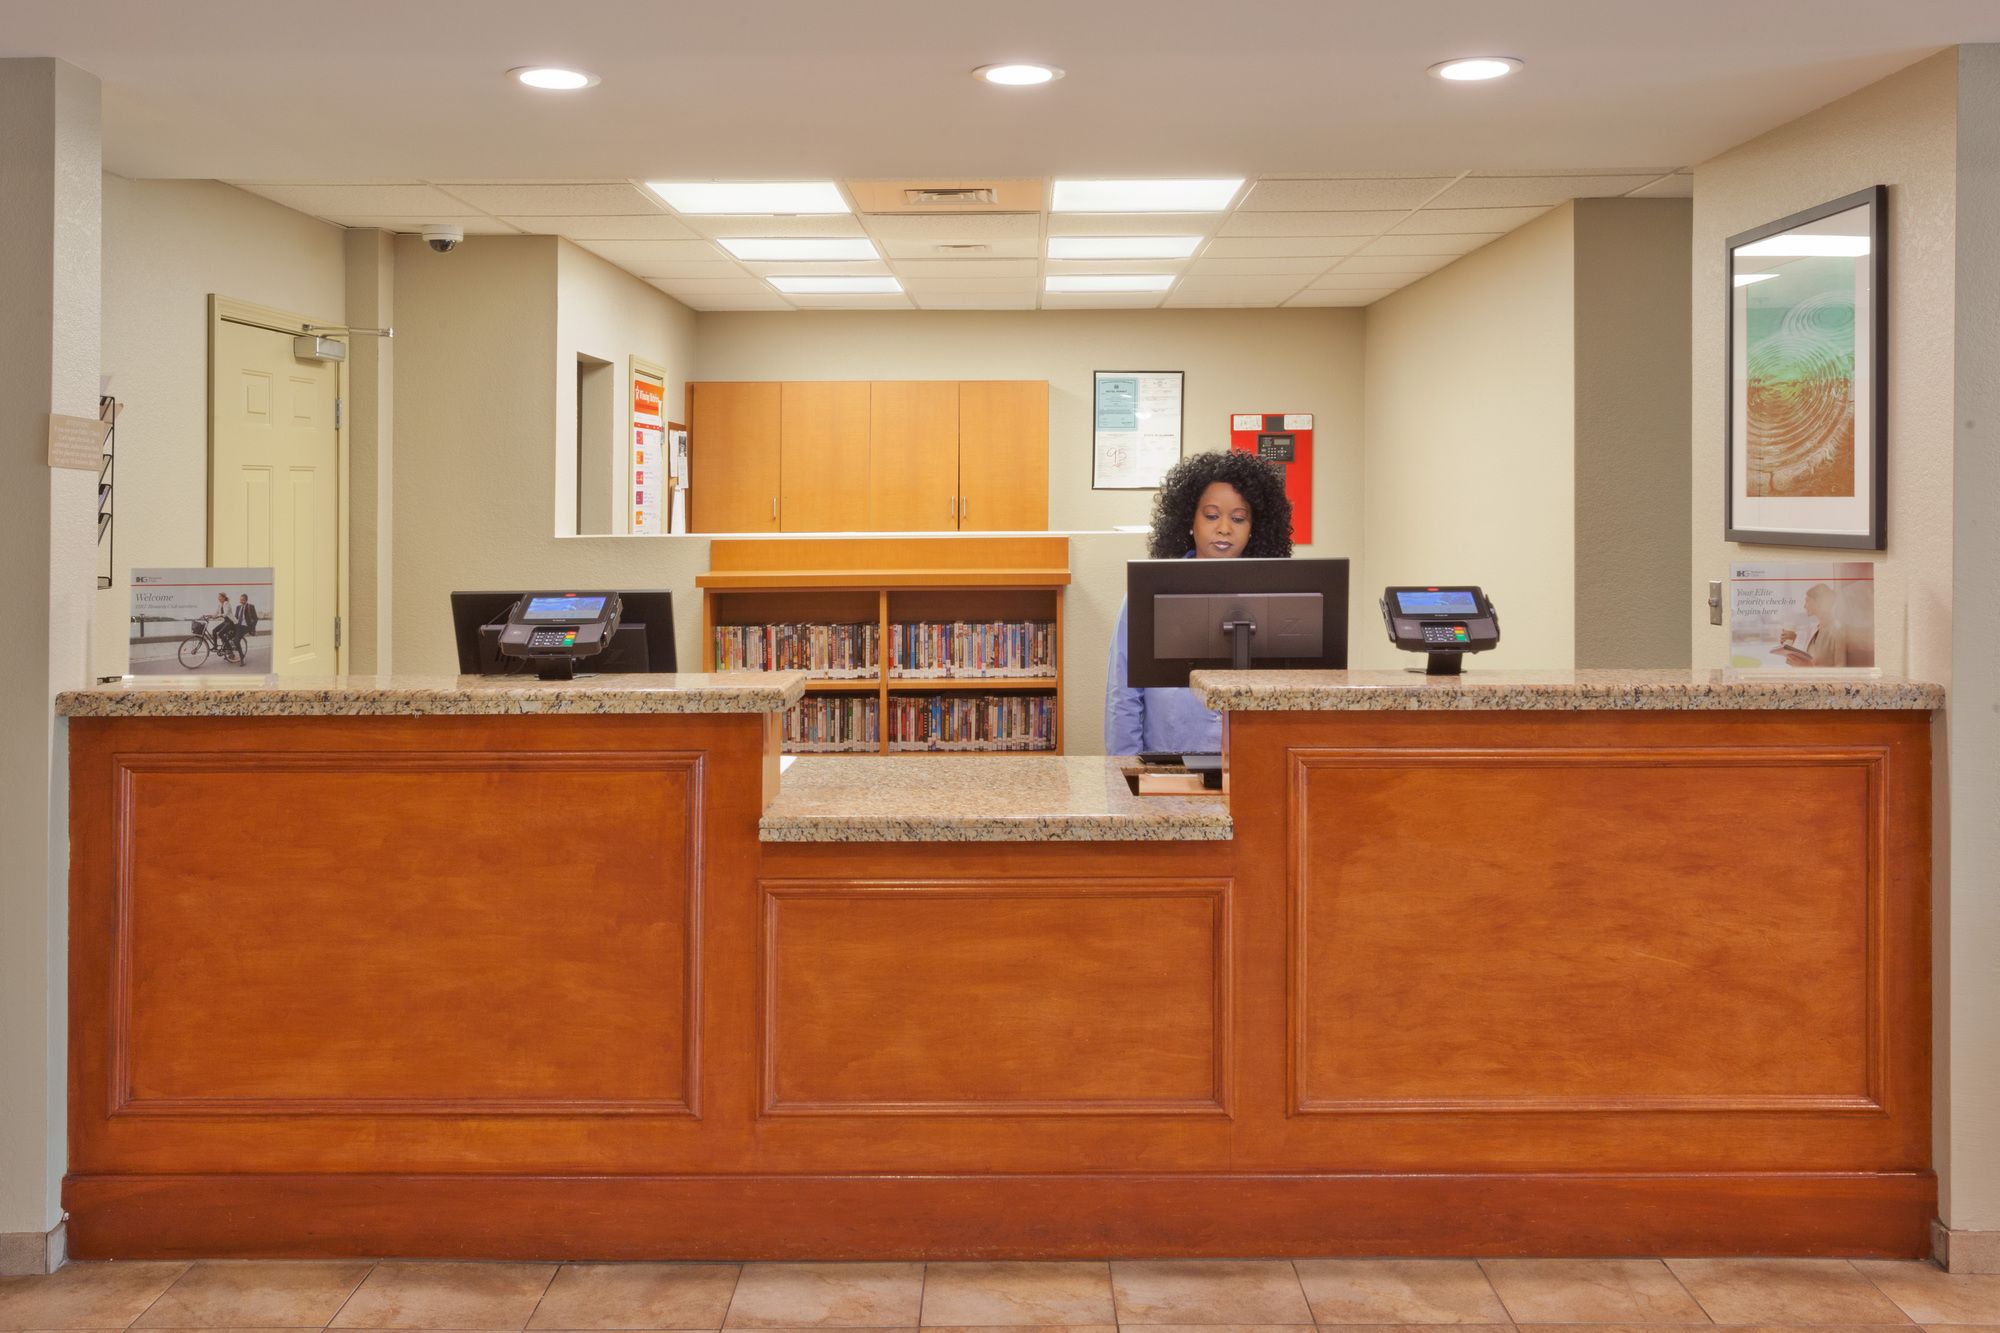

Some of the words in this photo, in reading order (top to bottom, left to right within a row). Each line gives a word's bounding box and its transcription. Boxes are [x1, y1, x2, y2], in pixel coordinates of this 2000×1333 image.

[1737, 588, 1754, 596] Your
[1755, 588, 1773, 596] Elite
[136, 593, 174, 601] Welcome
[1737, 598, 1764, 607] priority
[1737, 608, 1761, 616] begins
